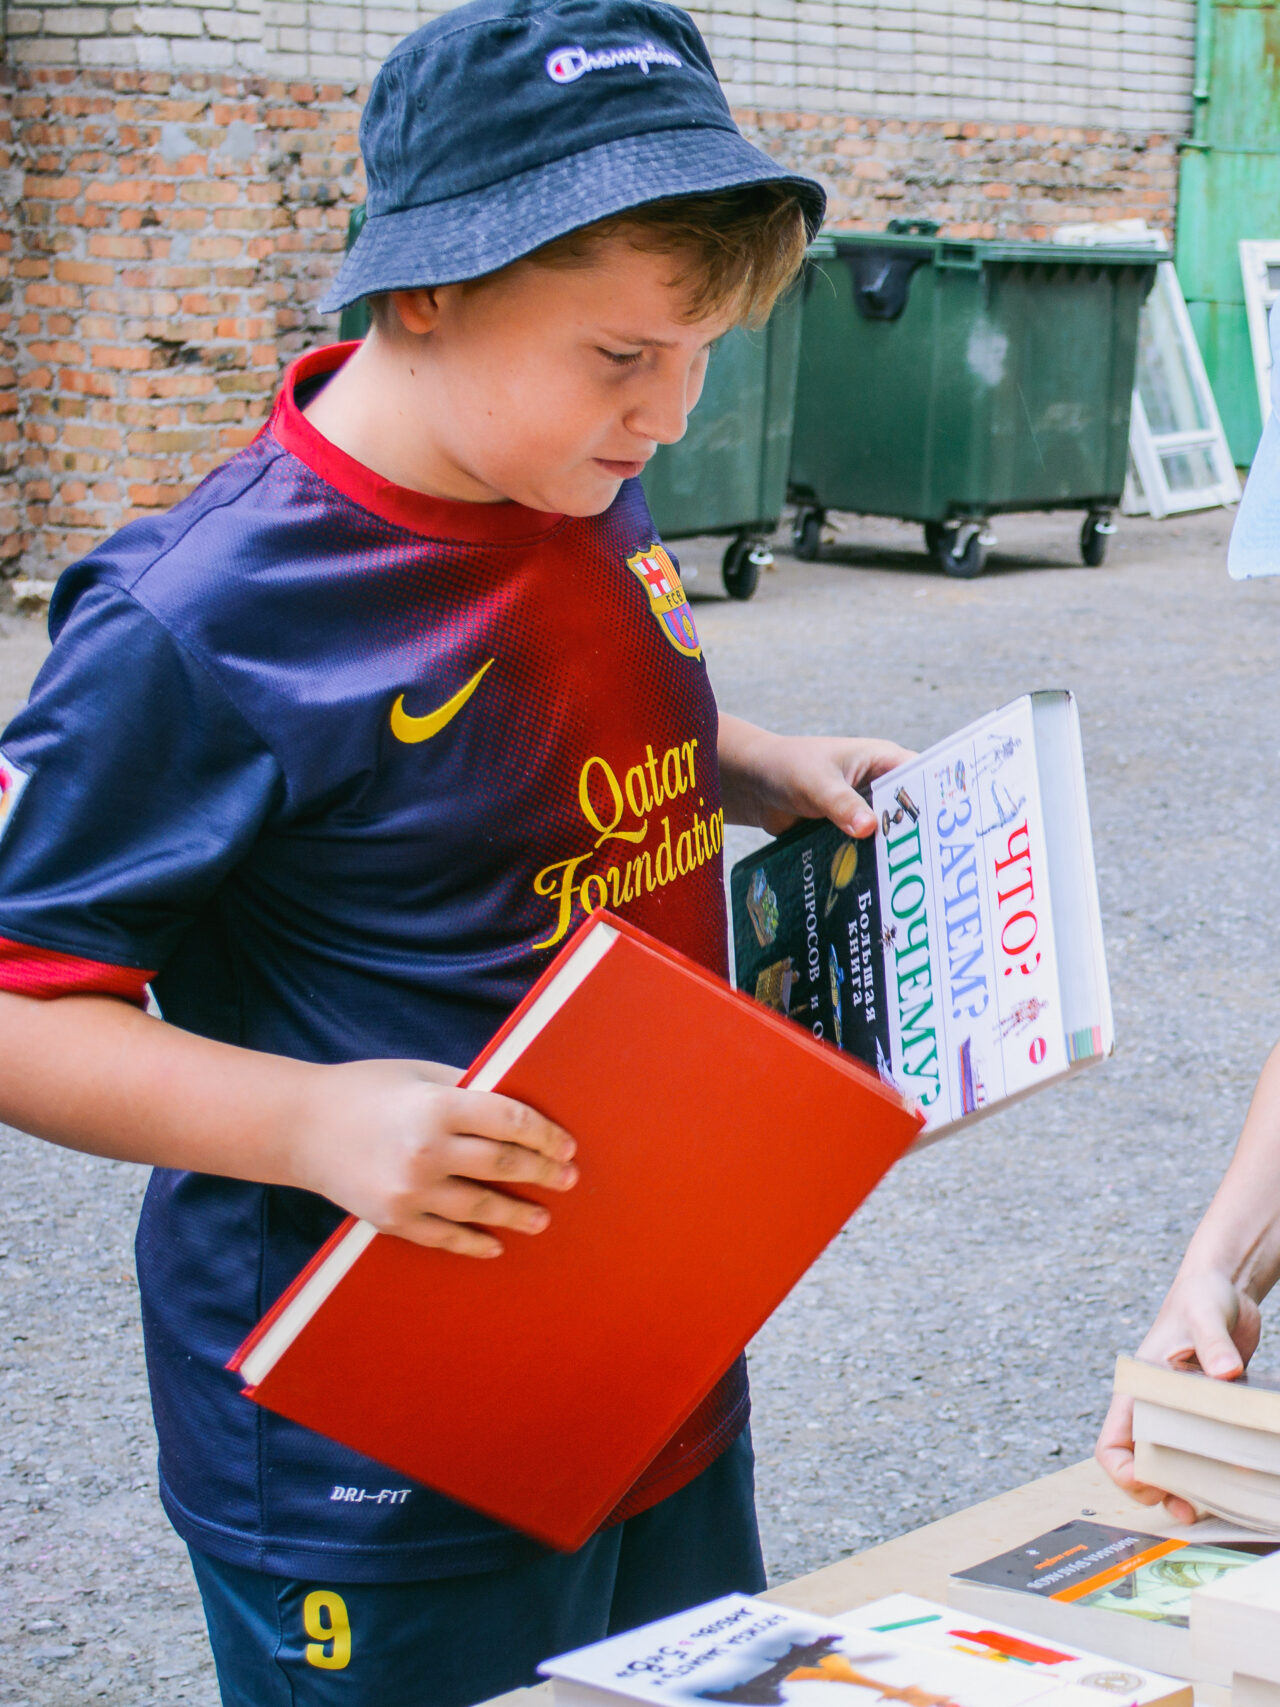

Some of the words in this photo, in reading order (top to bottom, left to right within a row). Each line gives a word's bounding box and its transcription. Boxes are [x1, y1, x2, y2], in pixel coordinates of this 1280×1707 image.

[665, 590, 684, 608] FCB
[579, 739, 698, 849] Qatar
[801, 848, 820, 983] ВОПРОСОВ
[858, 889, 877, 1024] Большая
[937, 799, 989, 1020] ЗАЧЕМ?
[995, 818, 1042, 977] ЧТО?
[848, 918, 863, 1007] книга
[885, 820, 942, 1108] ПОЧЕМУ?
[330, 1485, 412, 1504] DRI-FIT
[303, 1590, 352, 1671] 9
